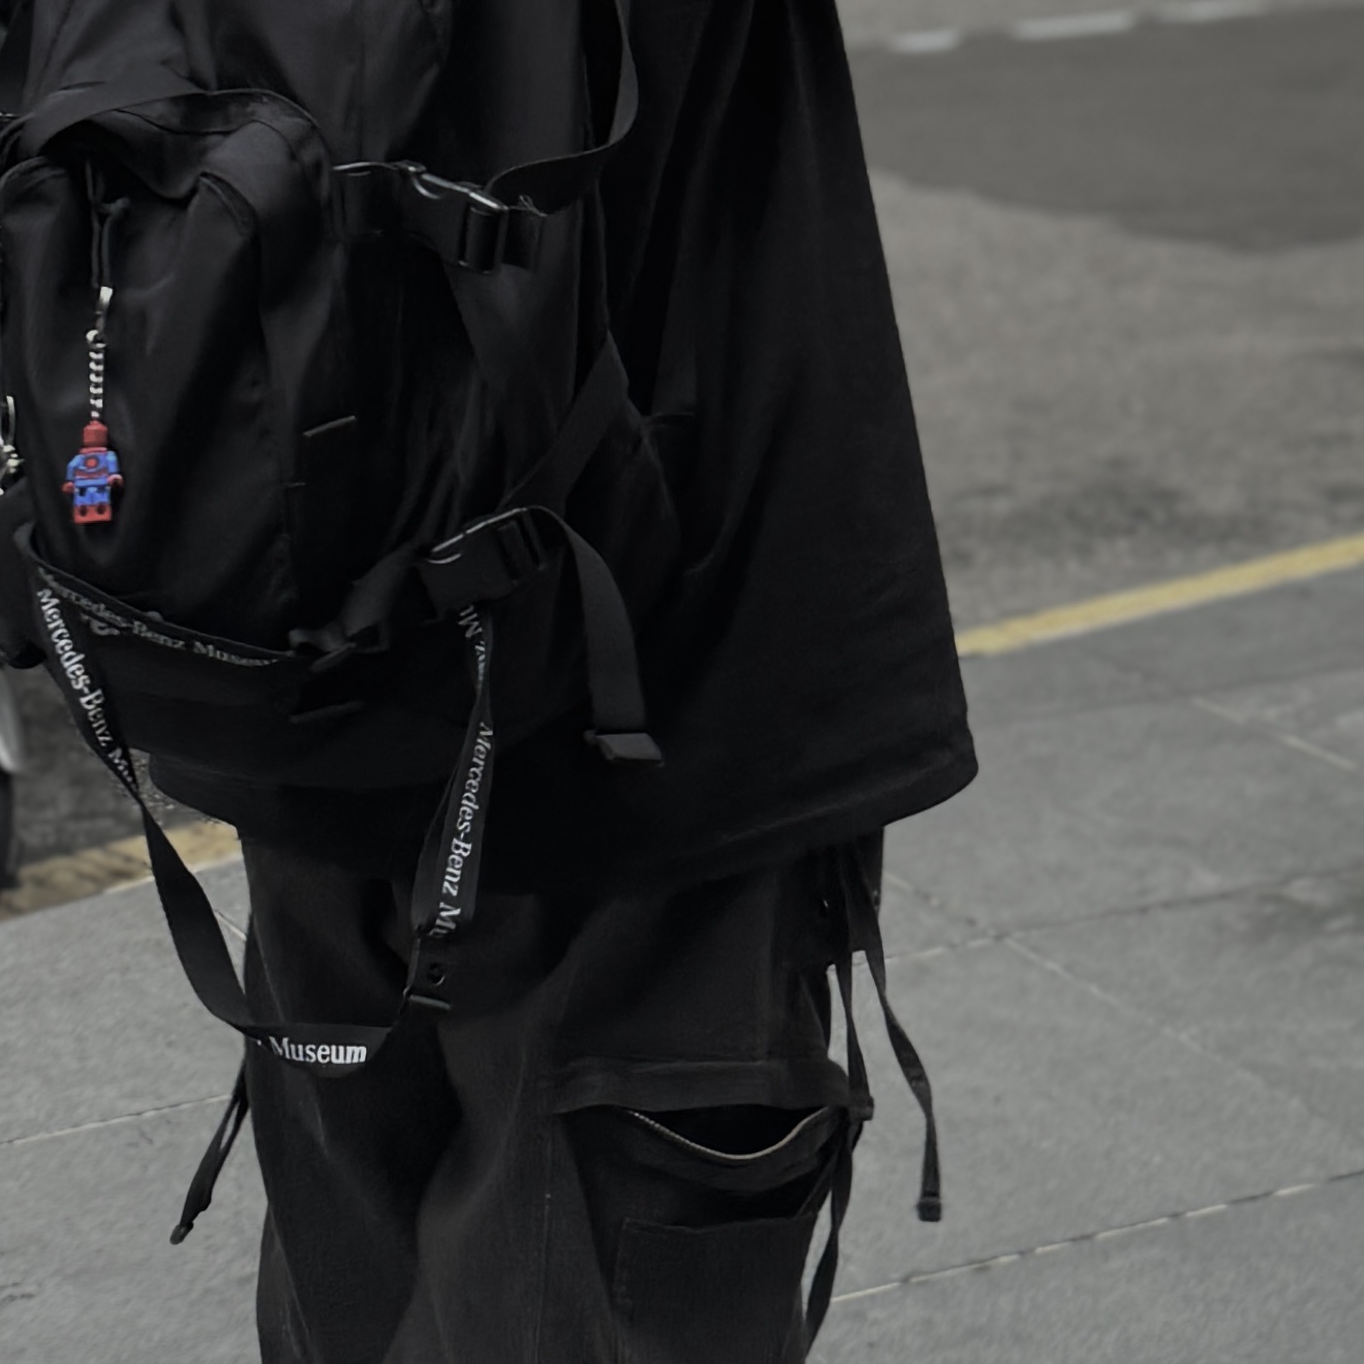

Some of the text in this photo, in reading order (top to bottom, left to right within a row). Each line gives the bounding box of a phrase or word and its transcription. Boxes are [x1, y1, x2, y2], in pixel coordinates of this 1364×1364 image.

[36, 588, 115, 748] Mercedes-Benz
[440, 720, 495, 898] Mercedes-Benz
[267, 1035, 368, 1066] Museum
